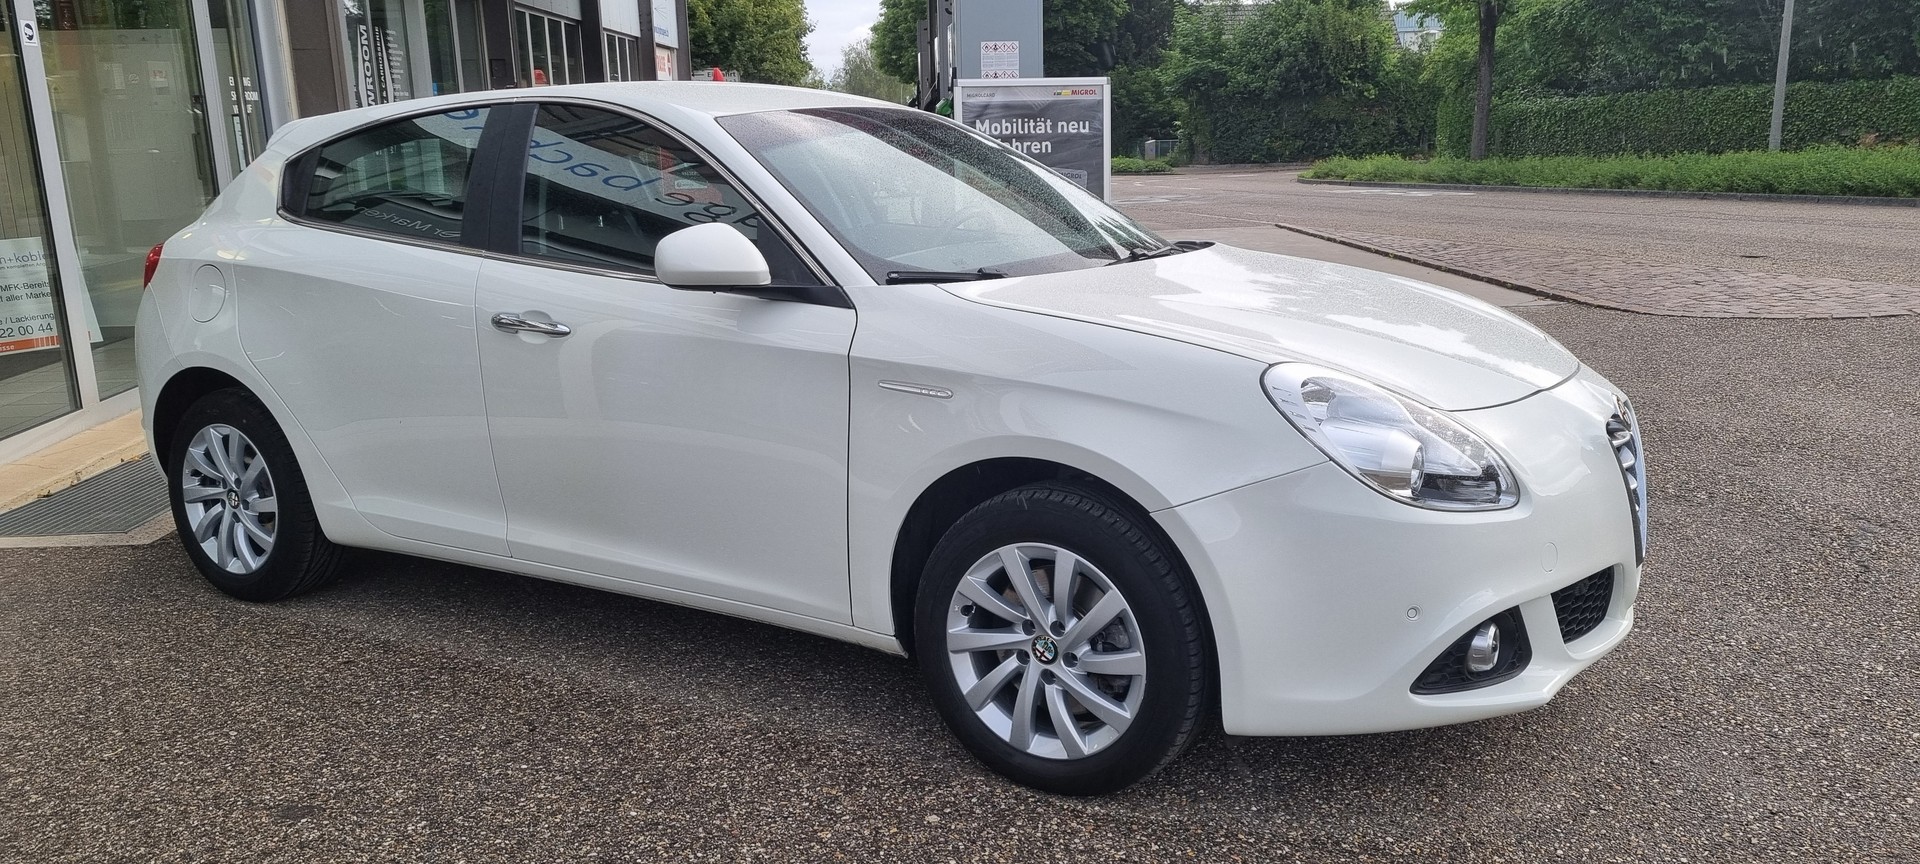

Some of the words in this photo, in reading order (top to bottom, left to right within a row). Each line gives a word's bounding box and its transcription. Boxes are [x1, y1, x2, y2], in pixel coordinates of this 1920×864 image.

[374, 26, 386, 88] CARROSSERIE
[975, 118, 1052, 135] Mobilität
[1057, 120, 1090, 134] neu
[998, 138, 1052, 153] hren
[5, 294, 24, 302] aller
[10, 313, 55, 324] Lackierung
[0, 327, 15, 338] 22
[18, 325, 34, 336] 00
[38, 322, 53, 333] 44
